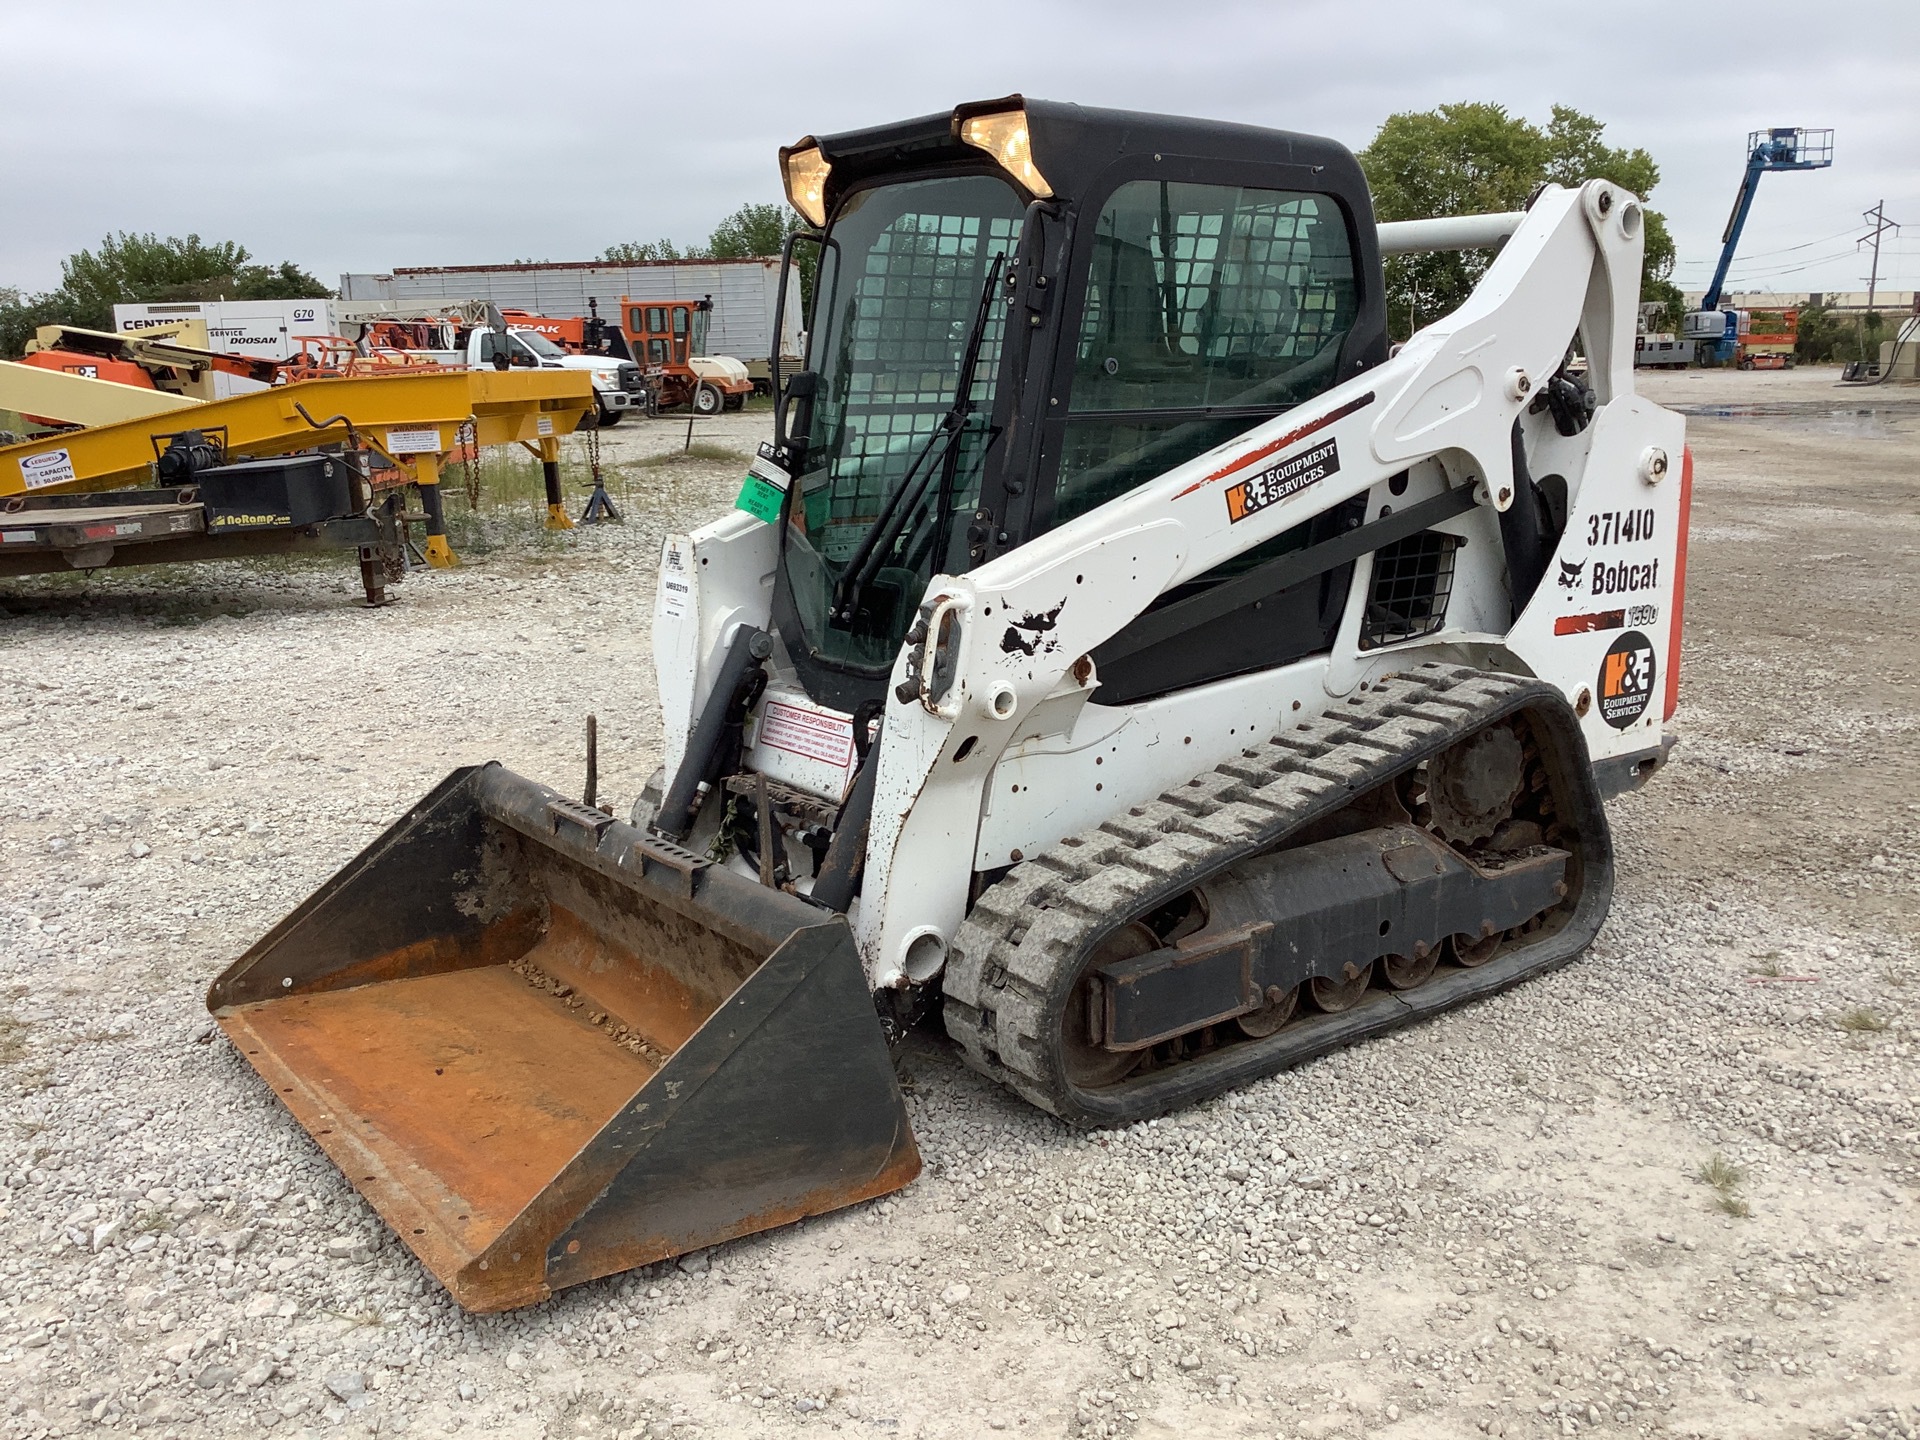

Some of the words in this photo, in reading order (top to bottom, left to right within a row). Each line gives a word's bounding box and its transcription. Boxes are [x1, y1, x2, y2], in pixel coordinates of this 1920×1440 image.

[123, 318, 190, 330] CENT
[293, 309, 315, 319] G70
[230, 337, 278, 345] DOOSAN
[39, 465, 72, 477] CAPACITY
[1266, 443, 1335, 486] EQUIPMENT
[1268, 465, 1325, 501] SERVICES
[1587, 508, 1655, 546] 371410
[1591, 557, 1659, 595] Bobcat
[1628, 604, 1659, 628] T590
[1604, 648, 1651, 698] H&E
[1603, 693, 1648, 710] EQUIPMENT
[1606, 704, 1642, 720] SERVICES
[772, 706, 802, 720] CUSTOMER
[802, 714, 846, 733] RESPONSIBILITY
